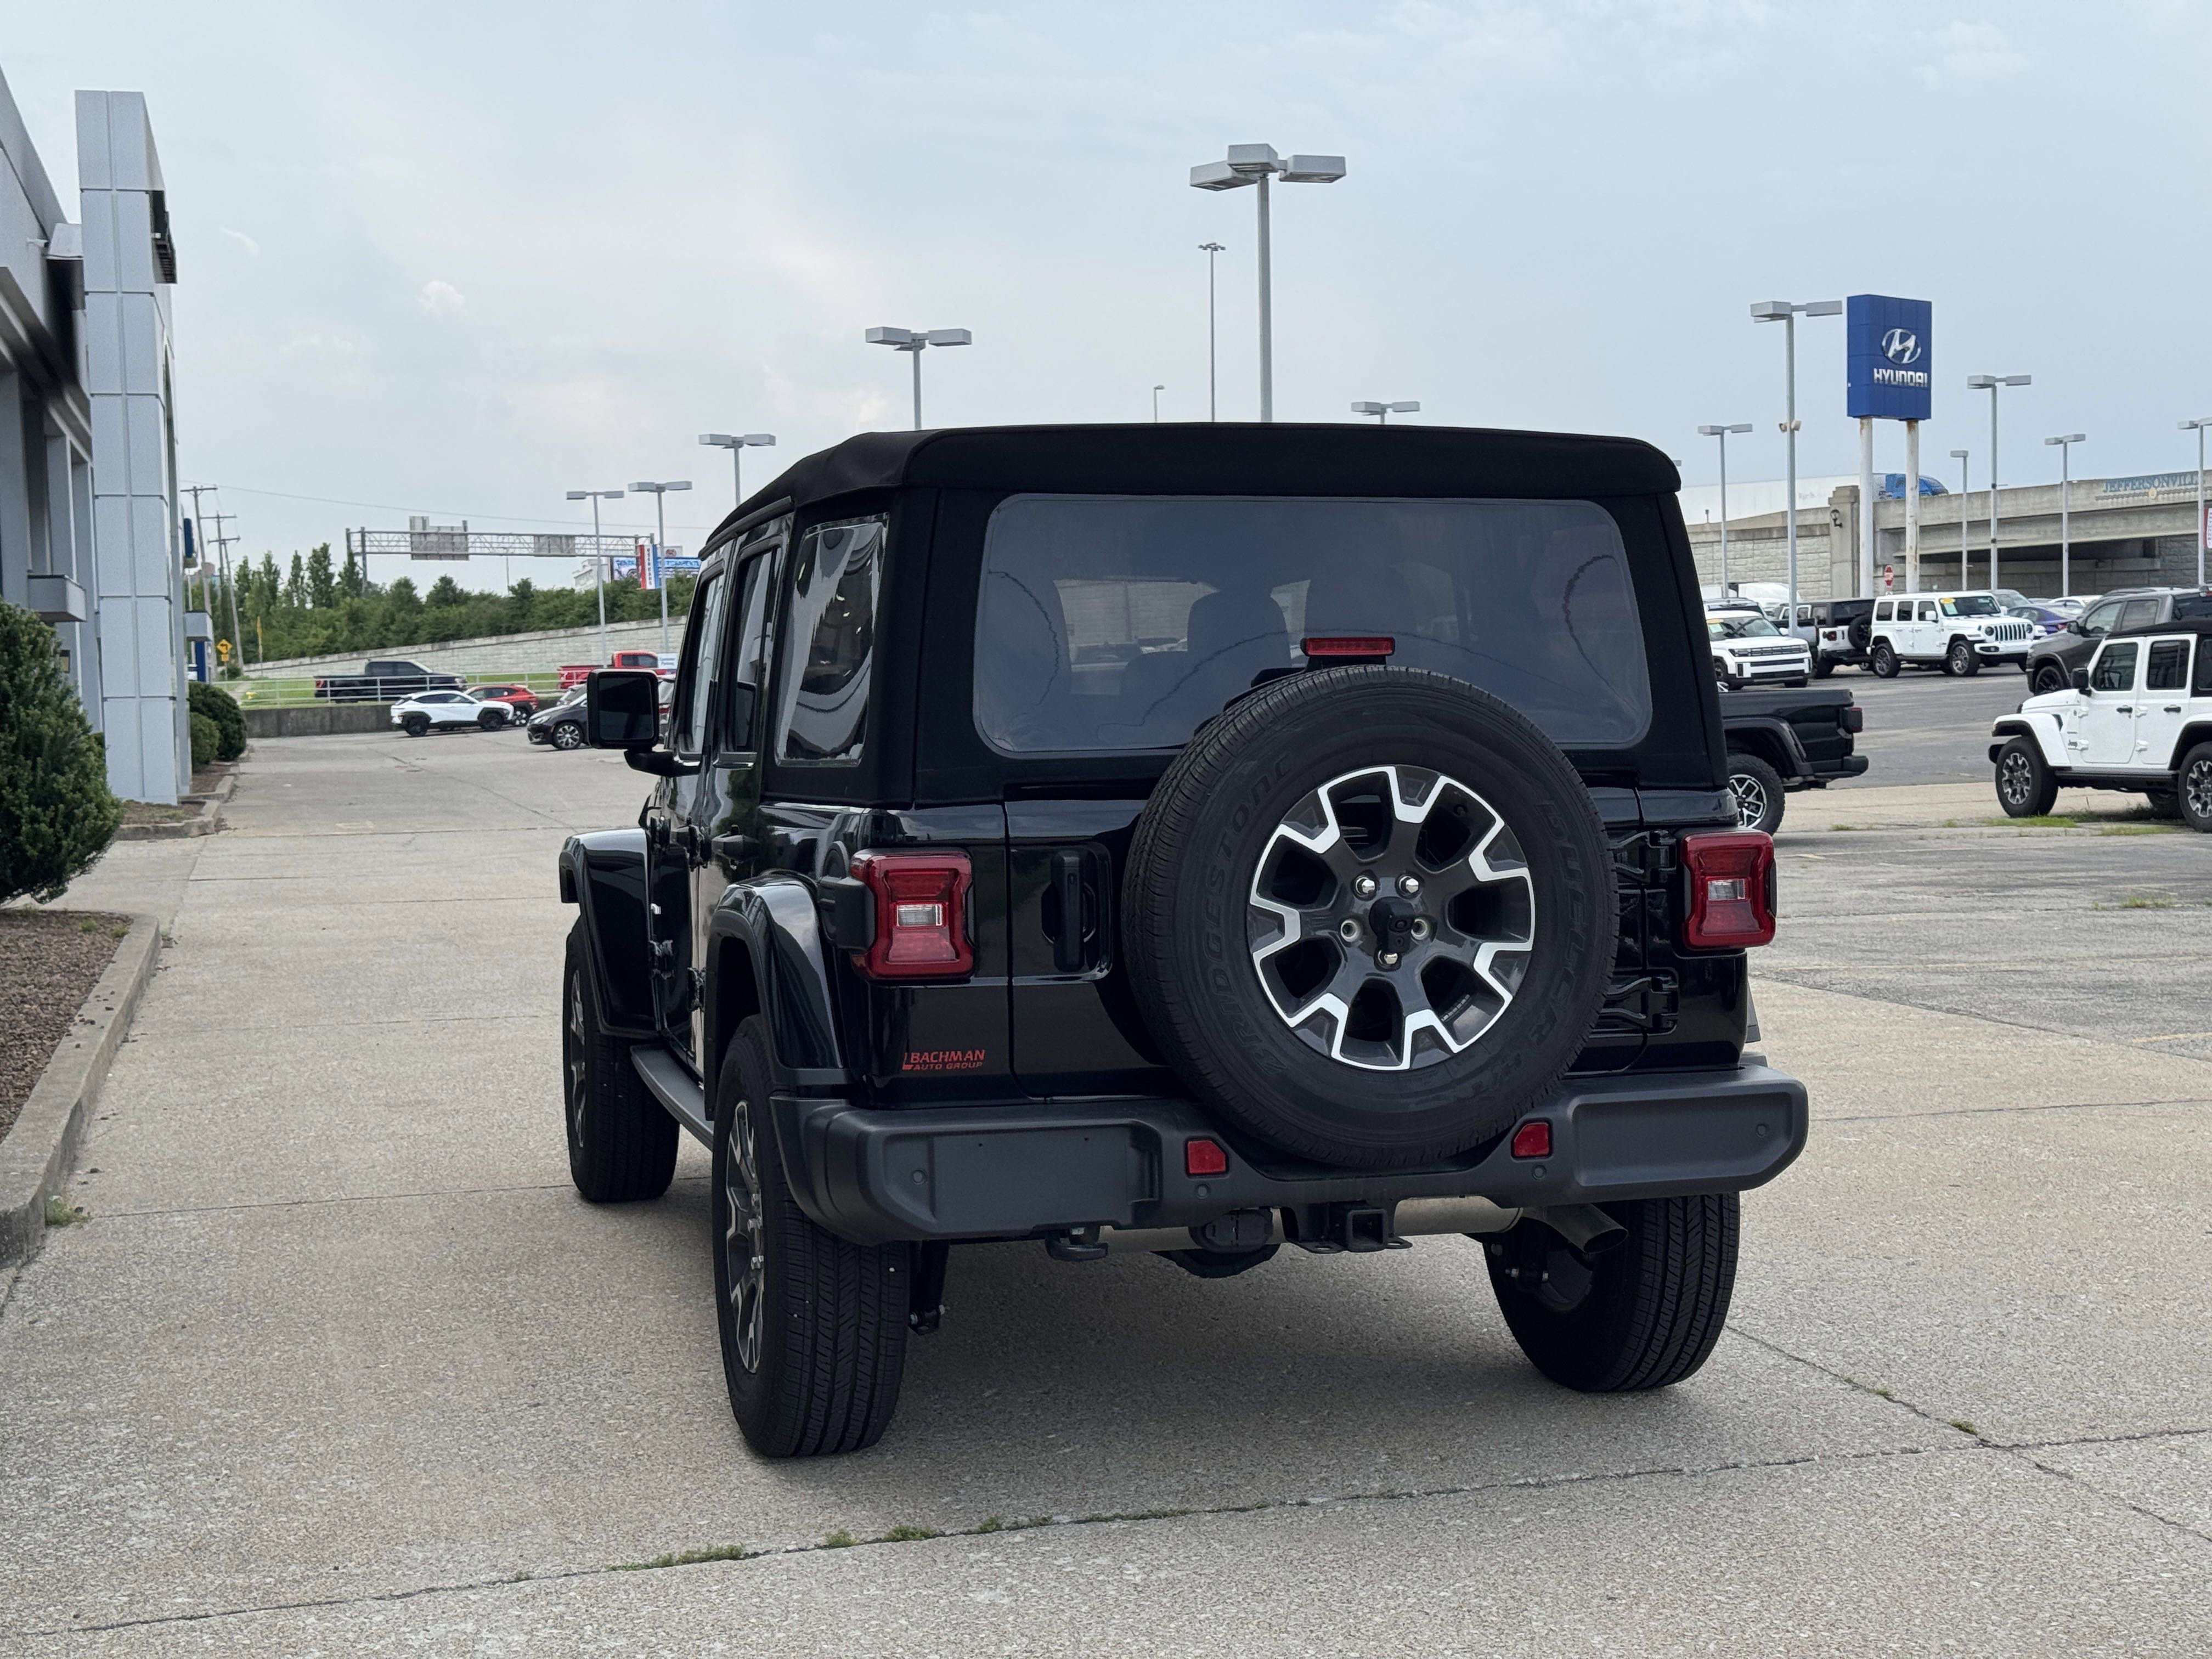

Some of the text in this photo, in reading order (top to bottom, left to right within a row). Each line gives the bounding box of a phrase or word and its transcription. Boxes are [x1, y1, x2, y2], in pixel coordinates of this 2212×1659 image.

[1874, 368, 1928, 387] HYUNDAI
[2103, 471, 2204, 492] JEFFERSONVILL
[911, 1049, 985, 1063] BACHMAN
